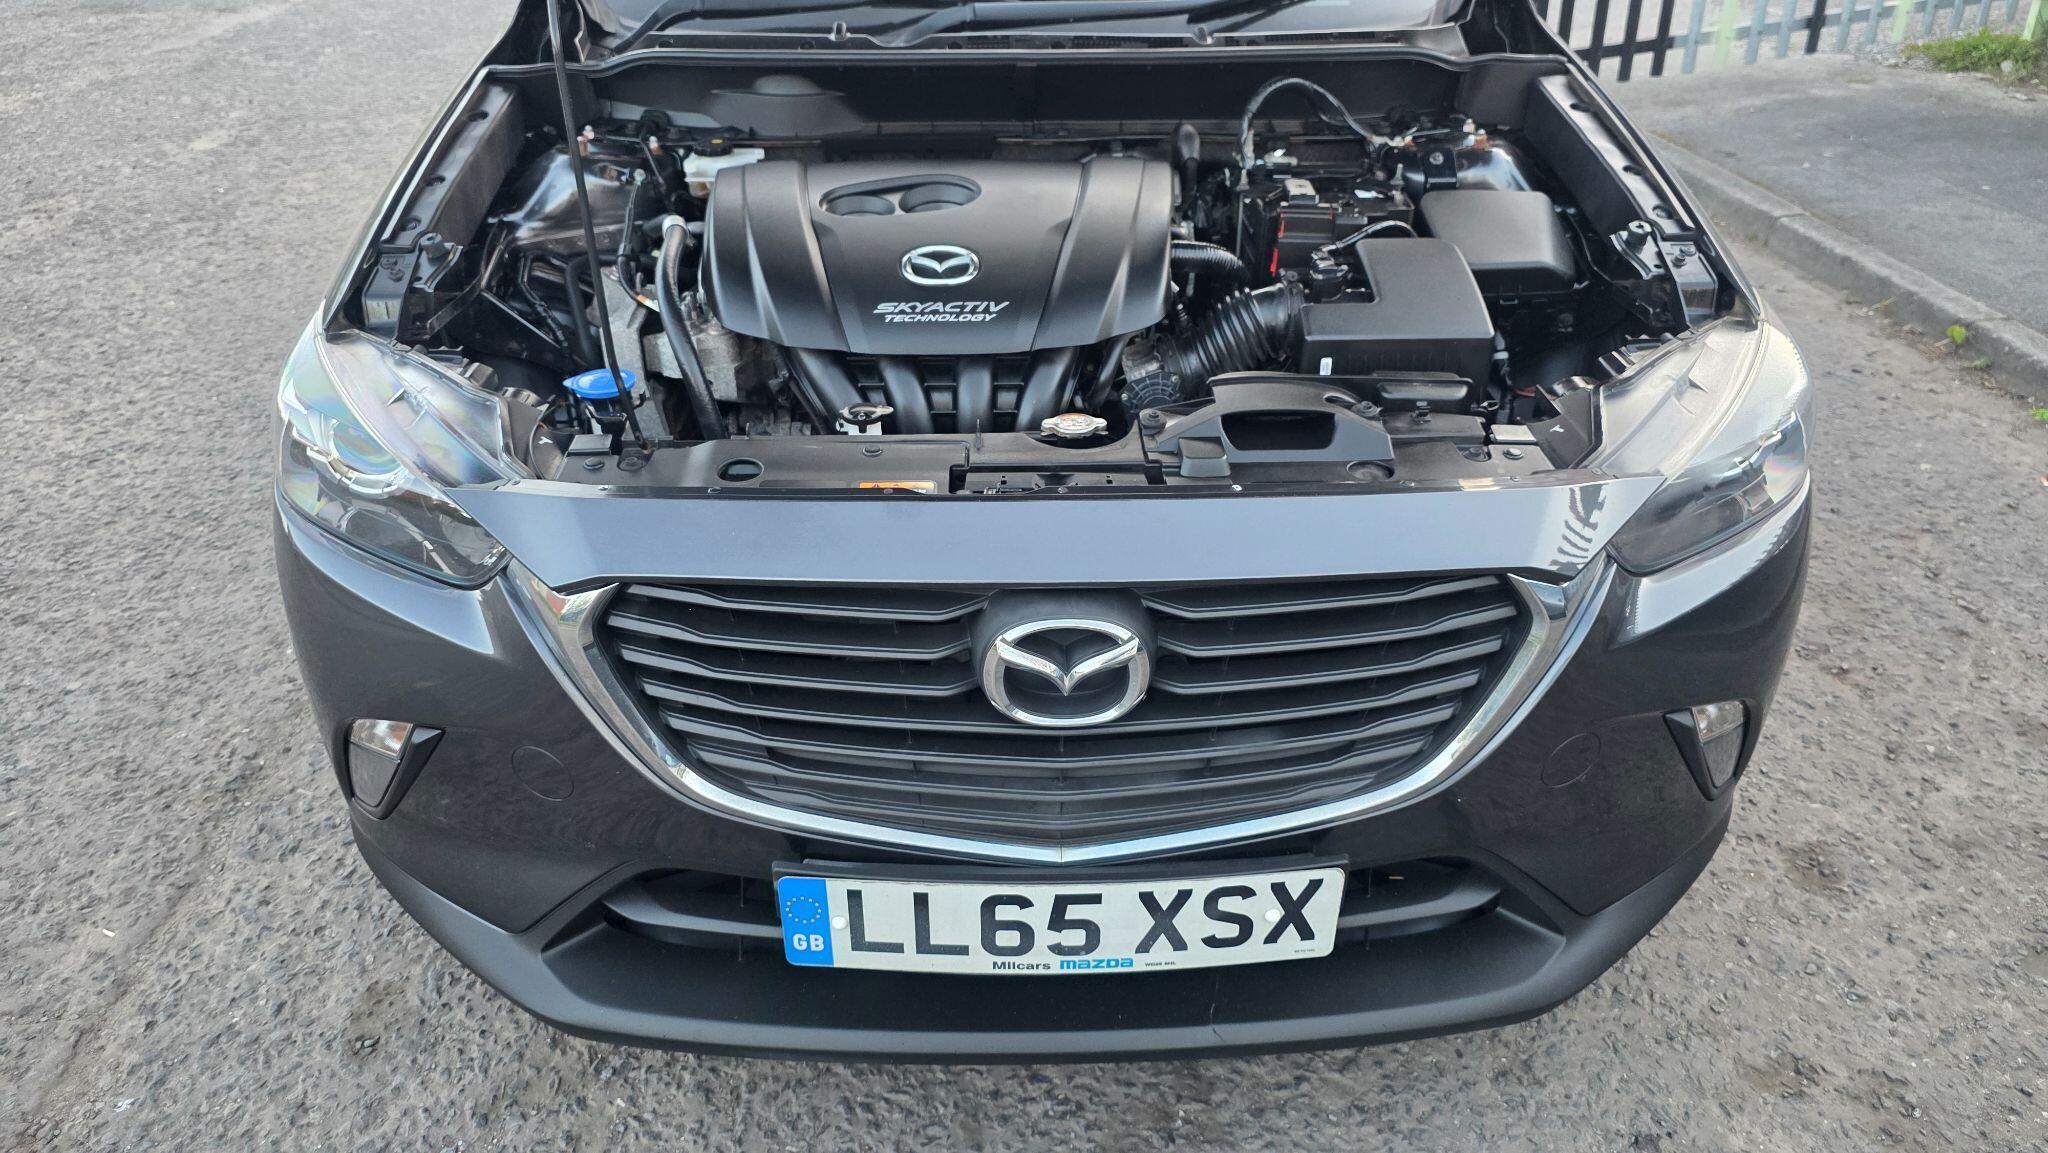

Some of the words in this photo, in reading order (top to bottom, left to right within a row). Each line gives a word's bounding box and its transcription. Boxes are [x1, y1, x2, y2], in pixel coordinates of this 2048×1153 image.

[873, 301, 1010, 314] SKYACTIV
[884, 313, 998, 323] TECHNOLOGY
[846, 888, 1103, 956] LL65
[1134, 878, 1324, 954] XSX
[792, 933, 825, 952] GB
[992, 960, 1051, 970] Milcars
[1059, 957, 1134, 970] mazda
